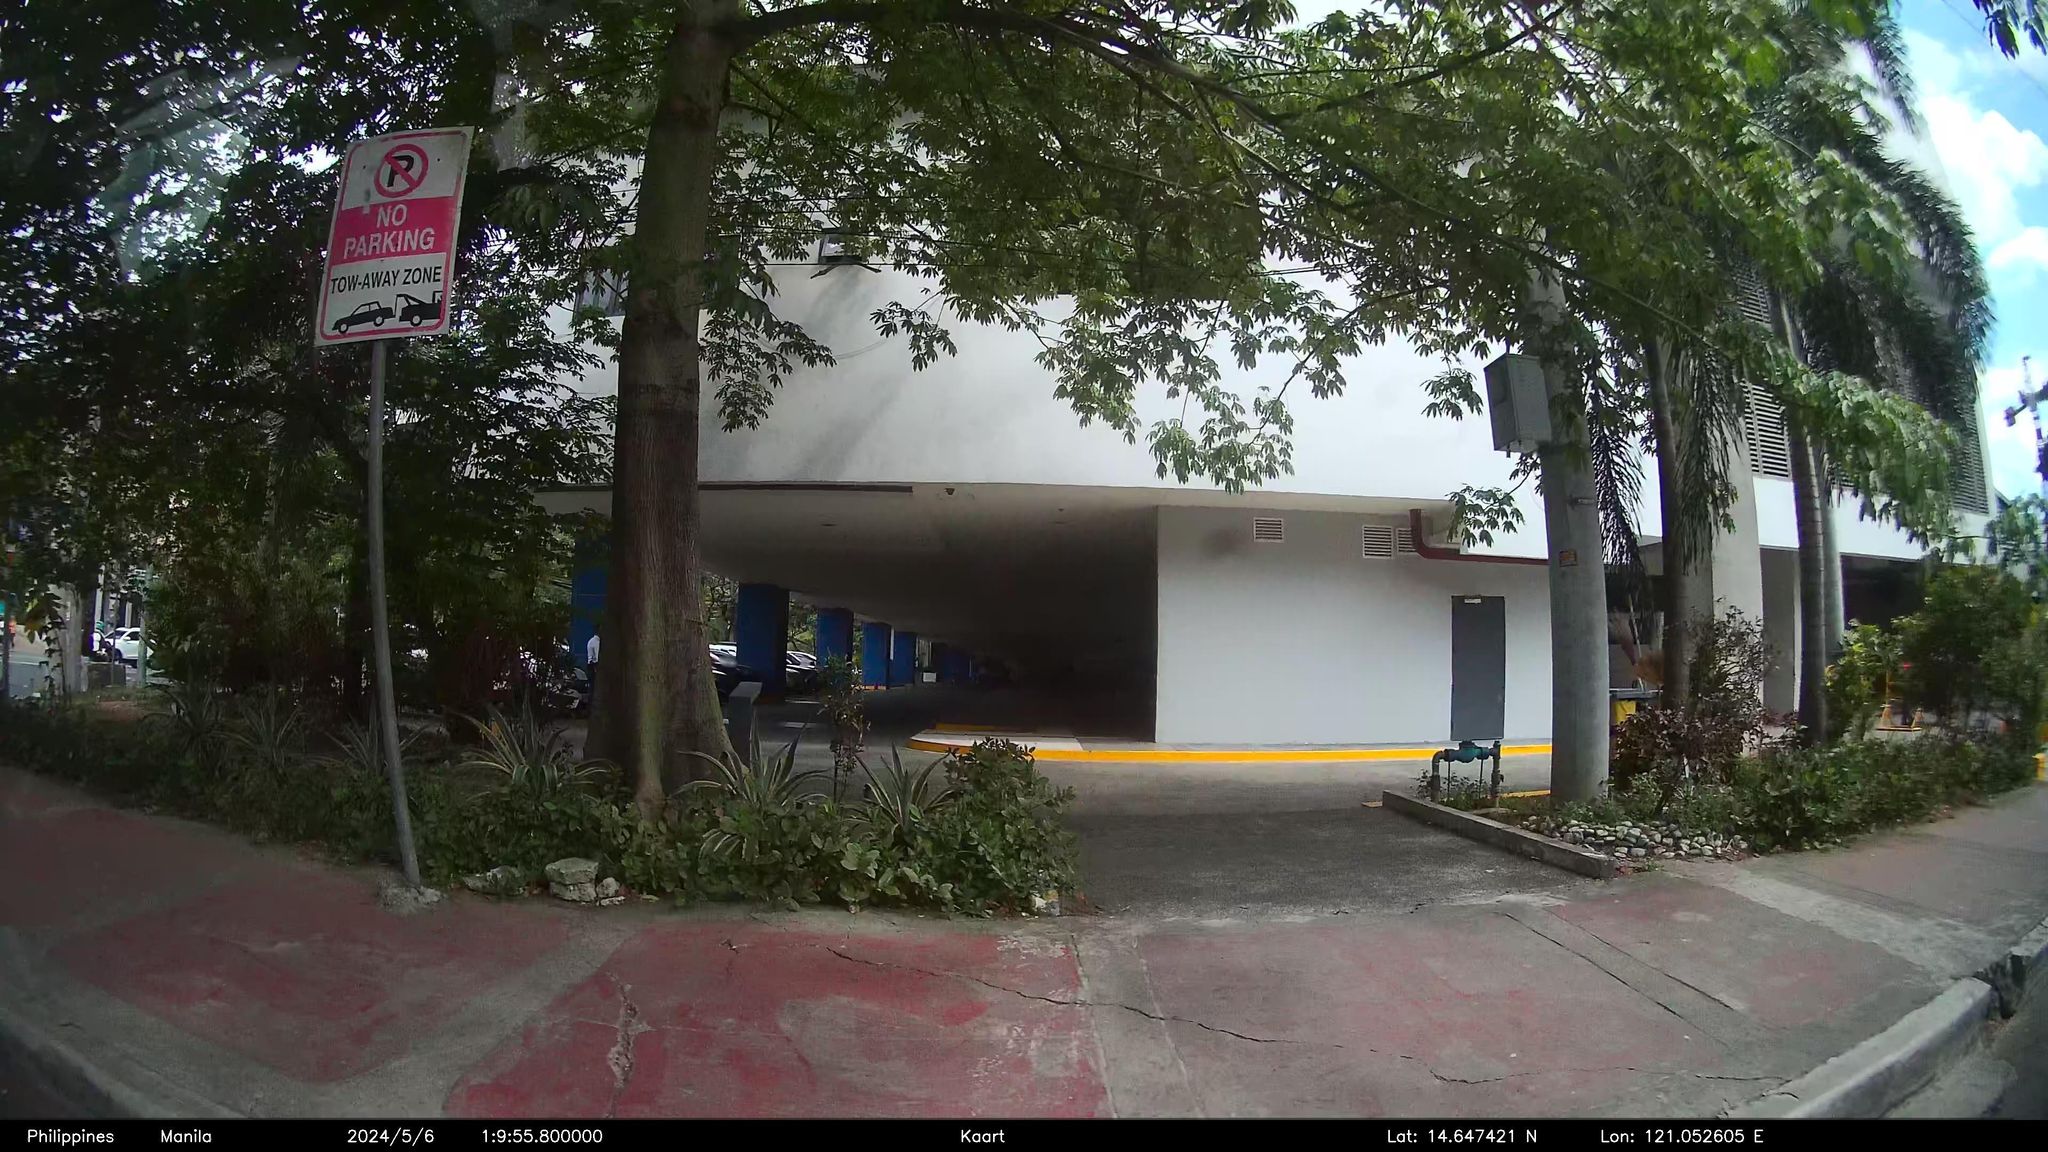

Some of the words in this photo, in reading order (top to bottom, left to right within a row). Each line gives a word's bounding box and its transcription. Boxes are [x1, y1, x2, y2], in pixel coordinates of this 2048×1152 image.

[377, 204, 407, 228] NO
[344, 228, 435, 259] PARKING
[331, 270, 399, 294] TOW-AWAY
[403, 266, 442, 285] ZONE
